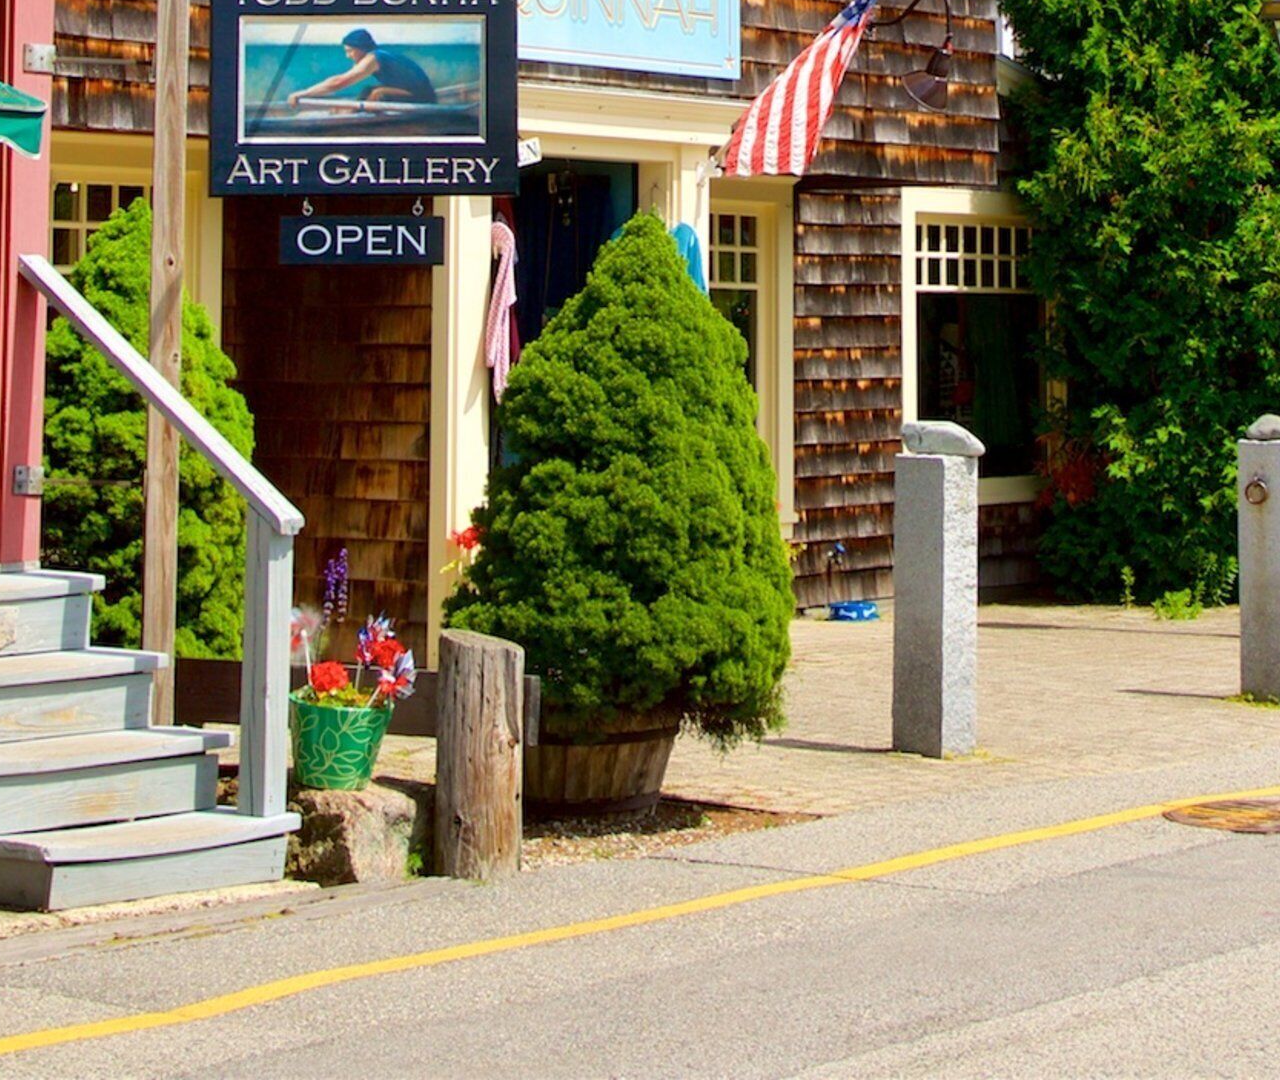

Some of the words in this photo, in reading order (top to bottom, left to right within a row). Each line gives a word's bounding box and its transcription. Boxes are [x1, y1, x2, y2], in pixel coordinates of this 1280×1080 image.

[226, 153, 308, 185] ART
[318, 153, 501, 186] GALLERY
[297, 224, 427, 256] OPEN
